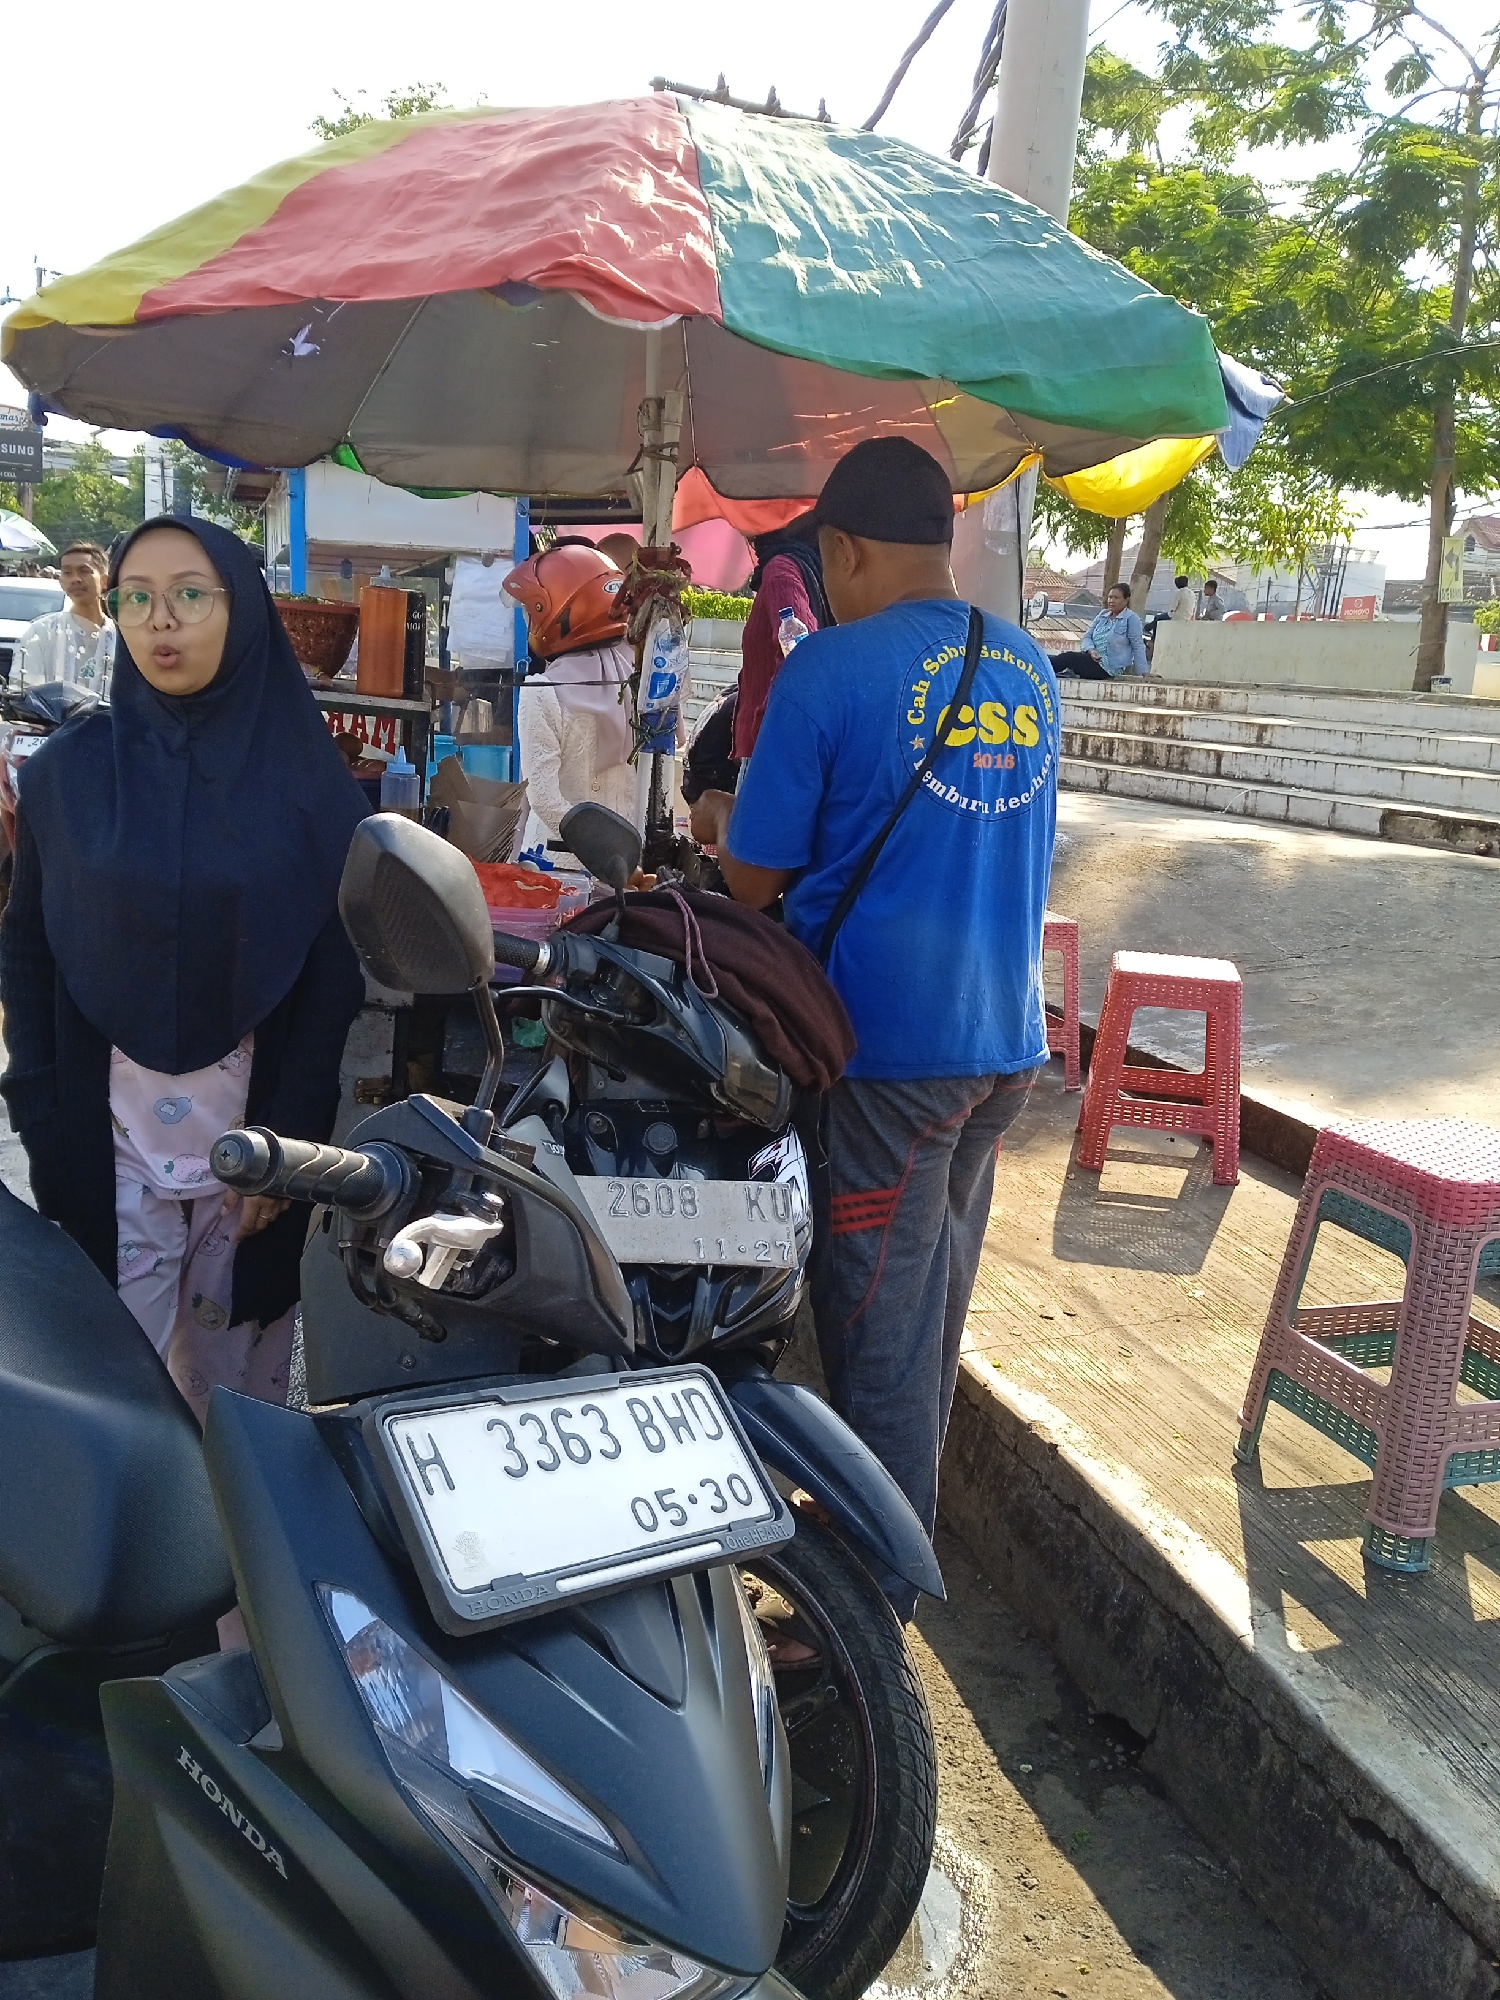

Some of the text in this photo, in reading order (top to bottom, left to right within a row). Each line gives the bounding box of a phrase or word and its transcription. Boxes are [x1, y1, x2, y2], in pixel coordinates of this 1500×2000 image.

[1, 443, 34, 456] SUNG
[907, 679, 931, 725] Cah
[936, 701, 1040, 748] CSS
[16, 737, 24, 745] H
[973, 752, 1016, 770] 2016
[994, 753, 1052, 814] Recehan
[607, 1180, 792, 1223] 2608 KU
[405, 1431, 456, 1496] H
[486, 1403, 622, 1479] 3363
[466, 1584, 553, 1616] HONDA
[725, 1534, 751, 1551] One
[177, 1745, 288, 1880] HONDA
